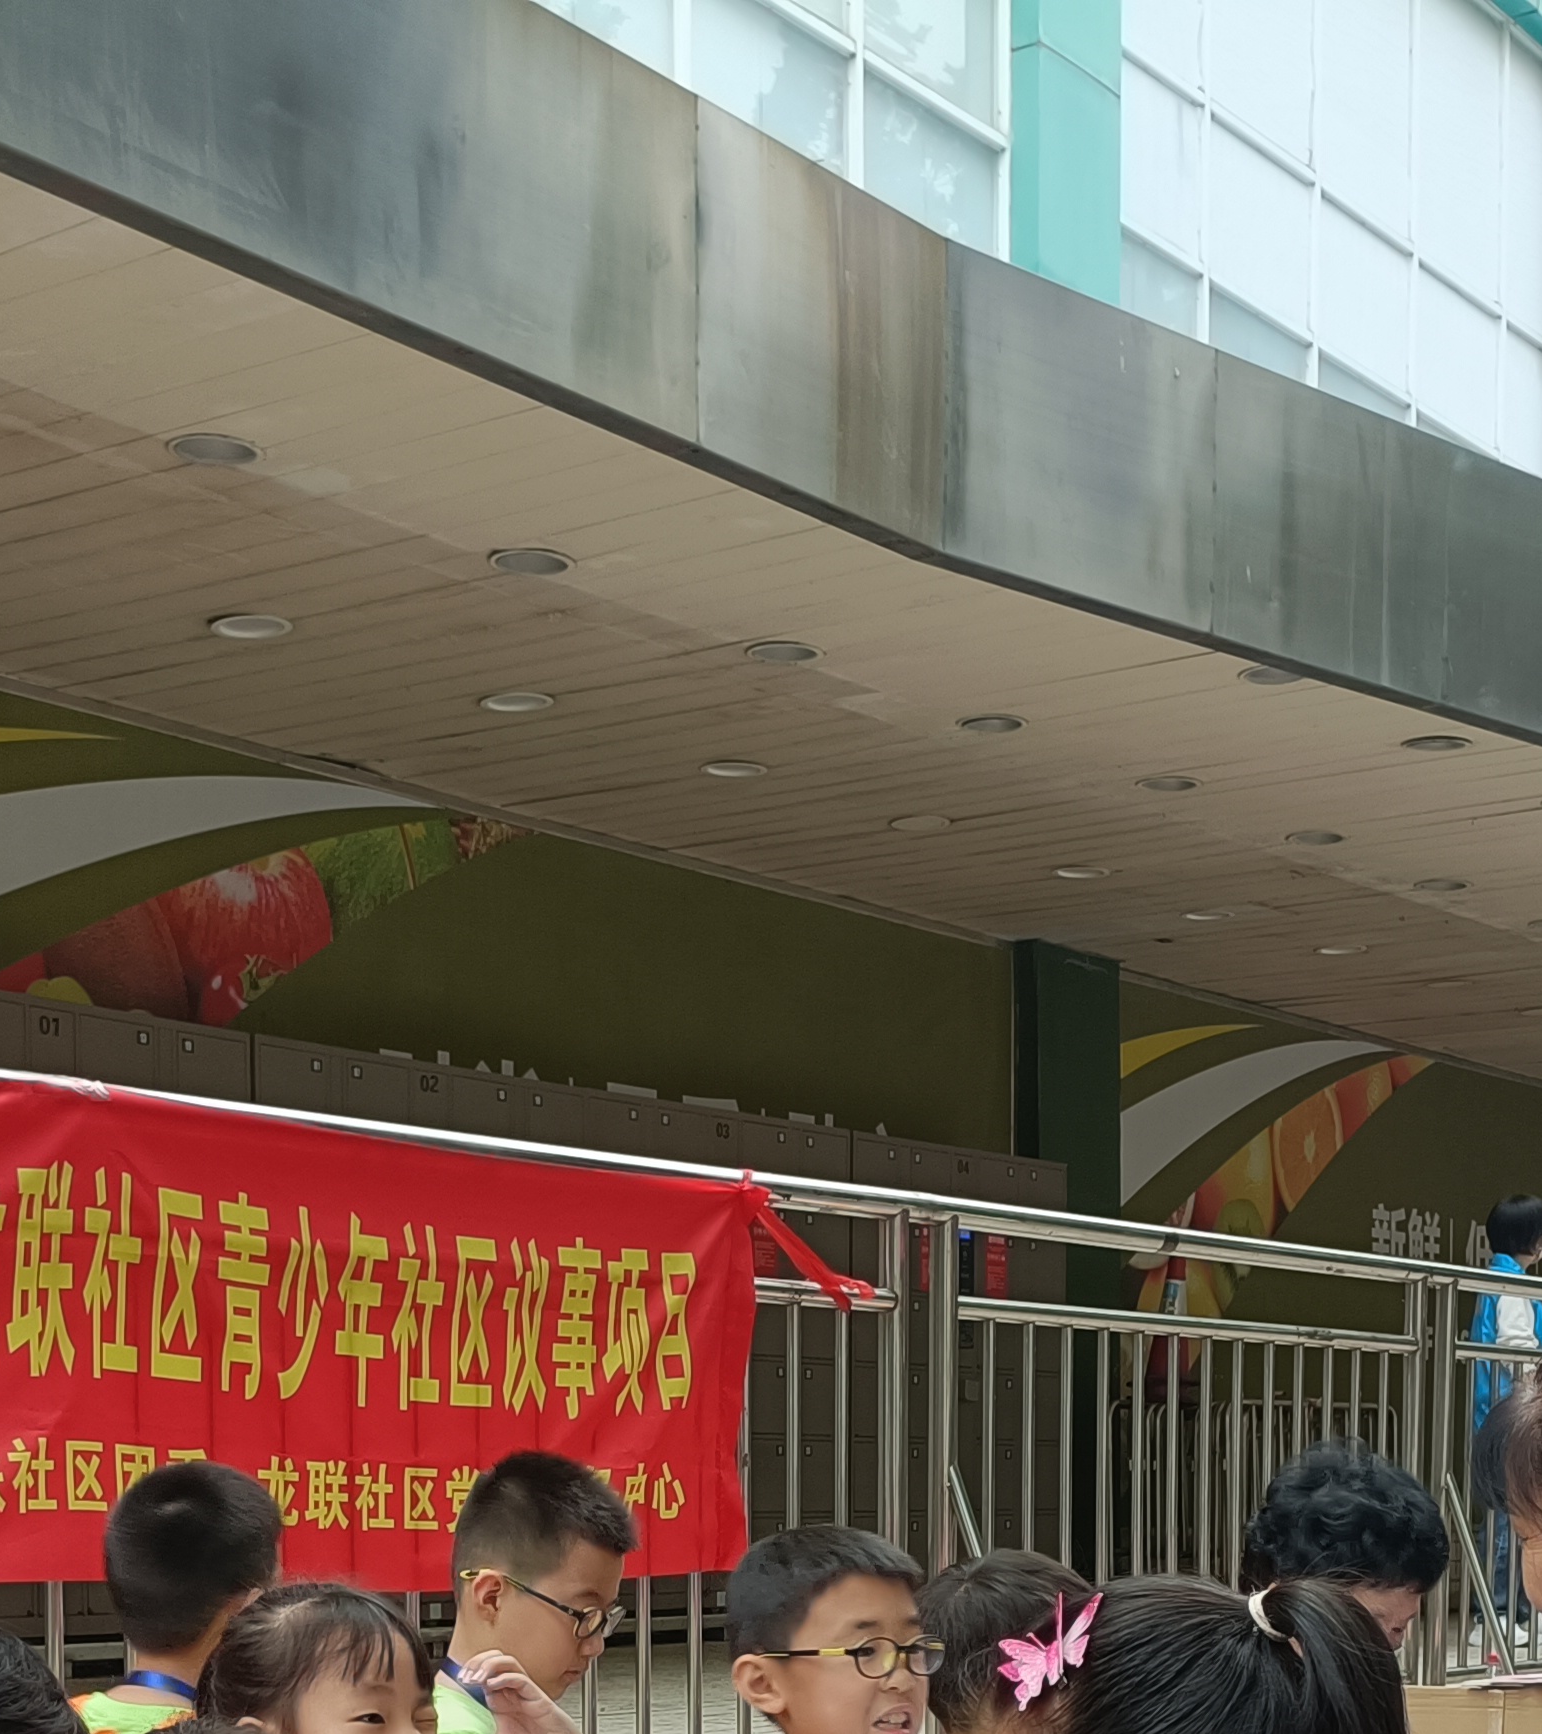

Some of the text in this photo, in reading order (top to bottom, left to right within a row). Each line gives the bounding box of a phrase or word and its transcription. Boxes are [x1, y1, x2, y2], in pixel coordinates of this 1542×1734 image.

[419, 1073, 440, 1093] 02
[715, 1122, 731, 1140] 03
[1371, 1203, 1441, 1260] 新鲜
